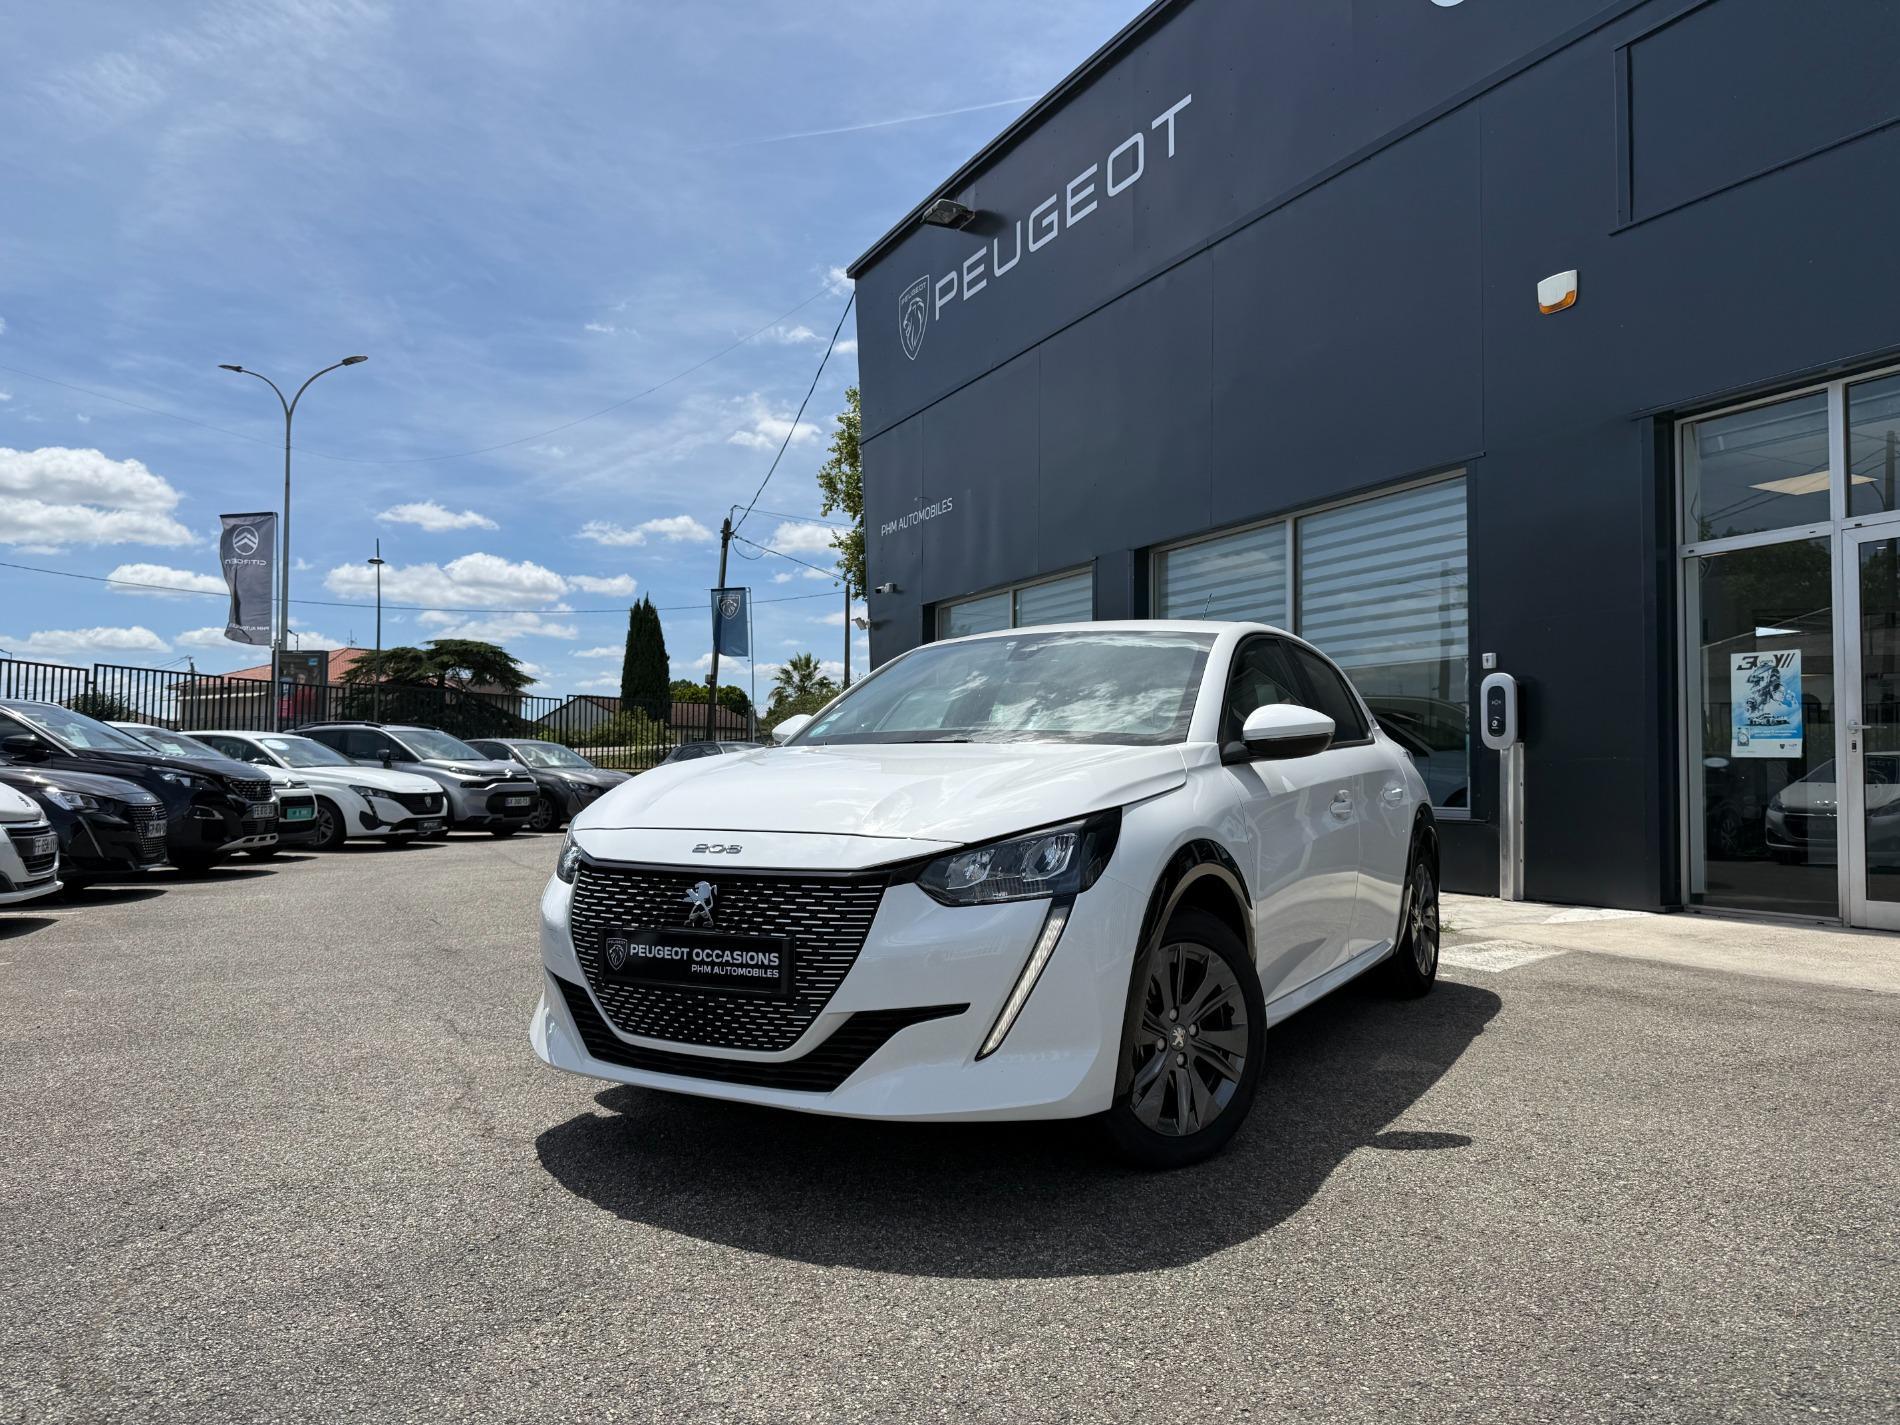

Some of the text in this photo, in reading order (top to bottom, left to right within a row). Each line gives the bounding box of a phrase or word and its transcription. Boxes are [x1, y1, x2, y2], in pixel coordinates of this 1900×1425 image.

[935, 93, 1192, 321] PEUGEOT
[881, 497, 953, 537] PHM AUTOMOBILES
[629, 943, 780, 966] PEUGEOT OCCASIONS
[691, 964, 780, 978] PHM AUTOMOBILES
